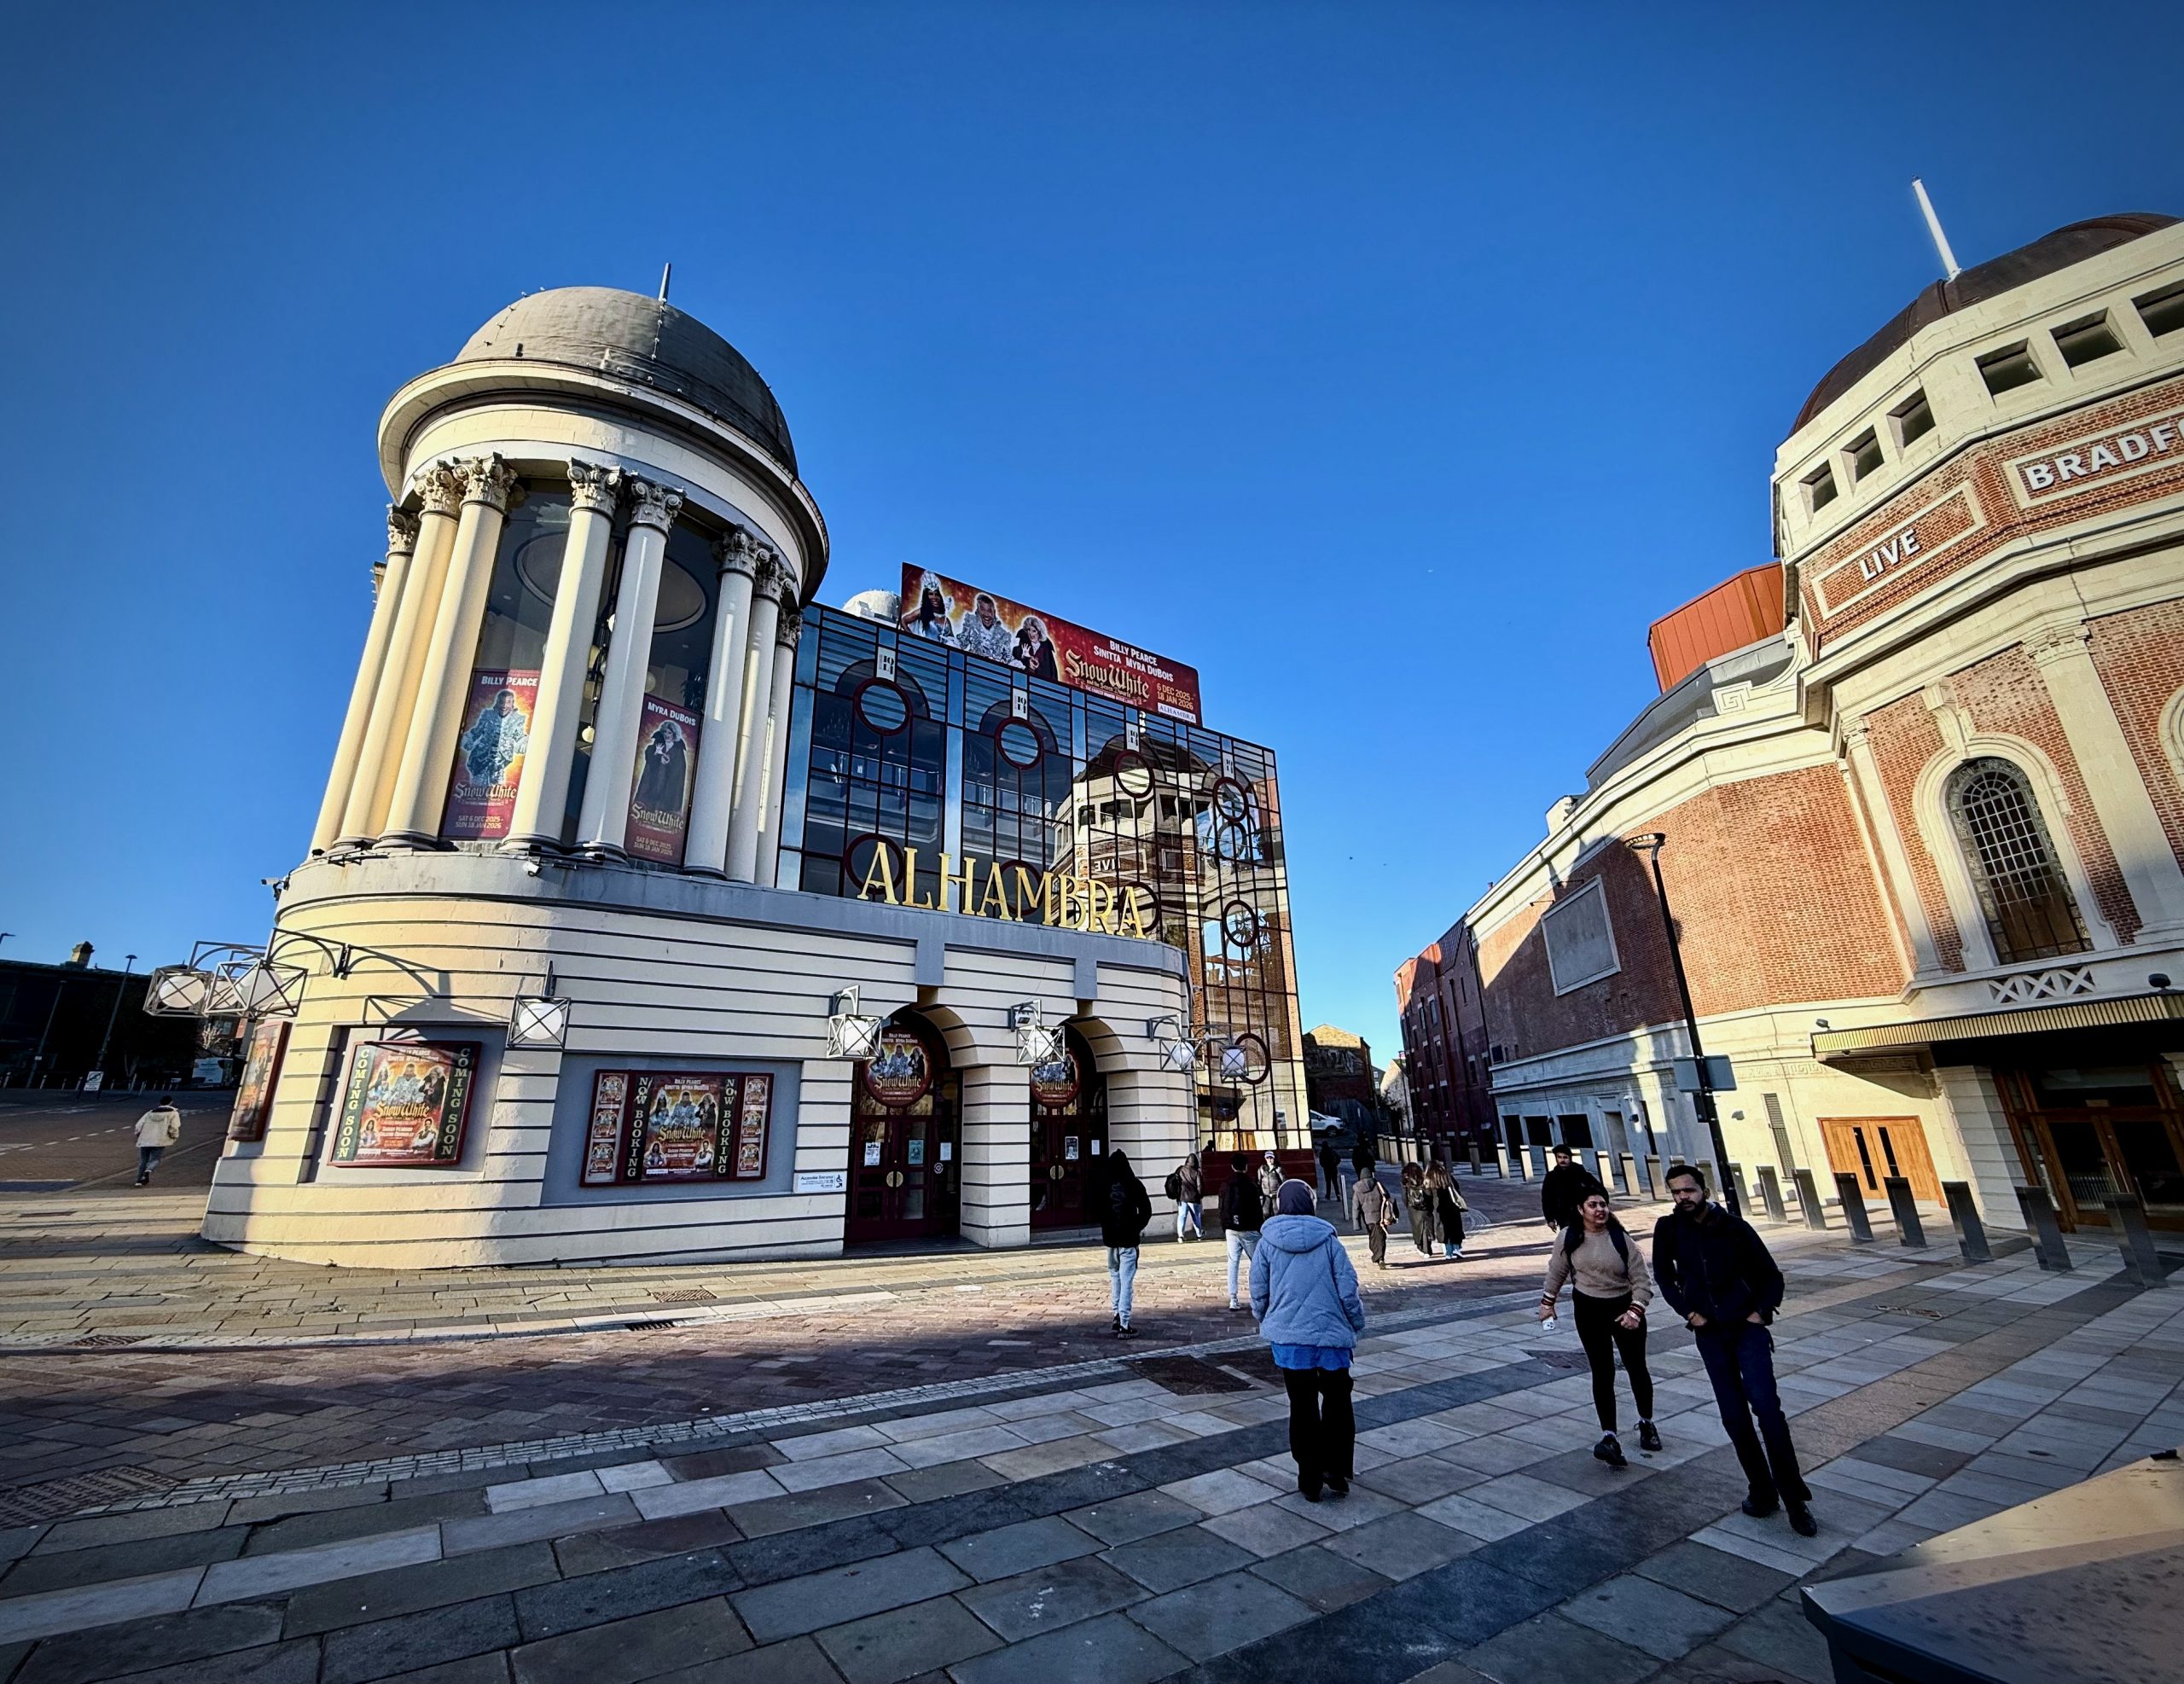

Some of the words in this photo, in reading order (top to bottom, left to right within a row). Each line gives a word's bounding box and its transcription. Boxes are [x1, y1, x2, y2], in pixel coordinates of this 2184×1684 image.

[2024, 418, 2184, 491] BRADF
[1858, 527, 1921, 581] LIVE
[1093, 645, 1121, 664] SINITTA
[1126, 659, 1146, 672] MYRA
[1109, 640, 1130, 656] BILLY
[1131, 648, 1158, 666] PEARCE
[481, 676, 505, 685] BILLY
[505, 677, 538, 687] PEARCE
[1065, 648, 1107, 682] Snow
[1108, 664, 1150, 699] White
[1157, 691, 1165, 701] 18
[1165, 694, 1178, 705] JAN
[1178, 698, 1194, 711] 2026
[1162, 684, 1175, 695] DEC
[1176, 689, 1191, 701] 2025
[648, 701, 668, 716] MYRA
[1159, 706, 1194, 721] ALHAMBRA
[453, 782, 485, 798] Snow
[485, 784, 517, 799] White
[630, 804, 658, 822] Snow
[658, 810, 684, 829] White
[857, 841, 1147, 938] ALHAMBRA
[349, 1048, 369, 1110] COMING
[450, 1048, 470, 1108] COMING
[636, 1077, 648, 1105] NOW
[724, 1079, 735, 1105] NOW
[374, 1100, 401, 1118] Snow
[401, 1102, 430, 1118] White
[339, 1115, 355, 1158] SOON
[442, 1113, 458, 1155] SOON
[627, 1110, 643, 1177] BOOKING
[718, 1110, 732, 1174] BOOKING
